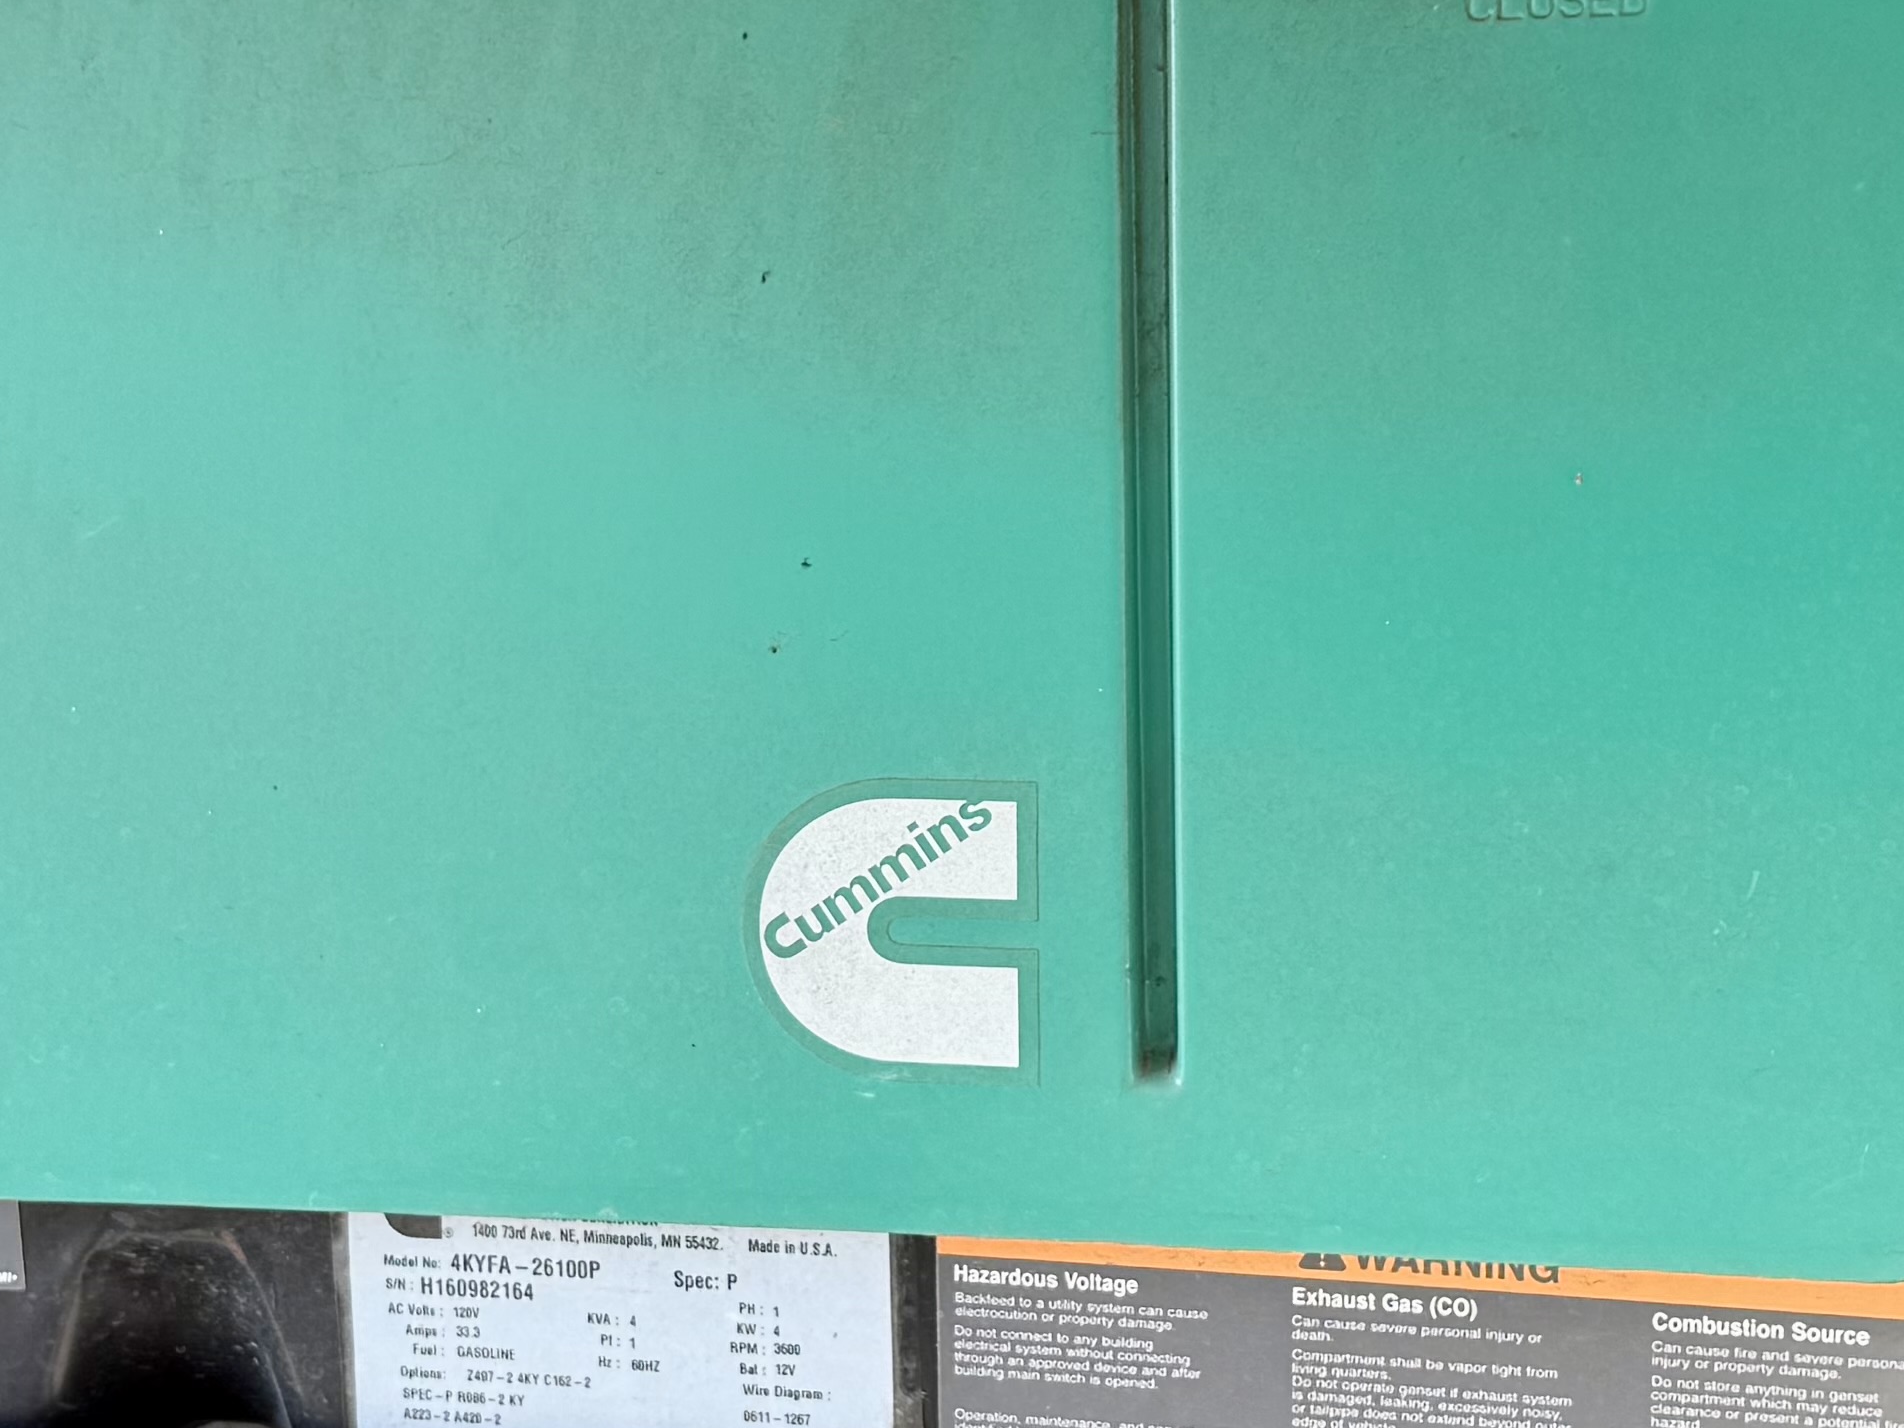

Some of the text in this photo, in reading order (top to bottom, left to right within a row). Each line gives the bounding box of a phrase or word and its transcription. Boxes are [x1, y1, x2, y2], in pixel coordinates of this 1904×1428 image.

[764, 800, 992, 959] Cummins
[472, 1224, 724, 1251] 1400 73rd Ave. NE, Minneapolis, MN 55432.
[748, 1239, 837, 1257] Made in U.S.A.
[384, 1254, 418, 1268] Model
[420, 1276, 534, 1301] H160982164
[674, 1270, 738, 1292] Spec: P
[954, 1264, 1139, 1297] Hazardous Voltage
[388, 1302, 404, 1314] AC
[453, 1306, 479, 1319] 120V
[773, 1305, 779, 1317] 1
[1292, 1286, 1478, 1322] Exhaust Gas (CO)
[629, 1315, 636, 1327] 4
[1652, 1311, 1871, 1346] Combustion Source
[456, 1326, 480, 1337] 33.3
[774, 1325, 780, 1336] 4
[457, 1346, 516, 1361] GASOLINE
[774, 1342, 801, 1356] 3600
[1651, 1340, 1681, 1354] Can
[1685, 1345, 1730, 1358] cause
[1734, 1347, 1757, 1359] fire
[1762, 1349, 1790, 1362] and
[400, 1365, 446, 1380] Options:
[631, 1359, 660, 1372] 60HZ
[775, 1364, 796, 1376] 12V
[1651, 1355, 1842, 1381] injury or property damage.
[743, 1384, 769, 1397] Wire
[1651, 1375, 1879, 1404] Do not store anything in genset
[509, 1394, 525, 1406] KY
[1651, 1391, 1883, 1417] compartment which may reduce
[1726, 1410, 1739, 1420] or
